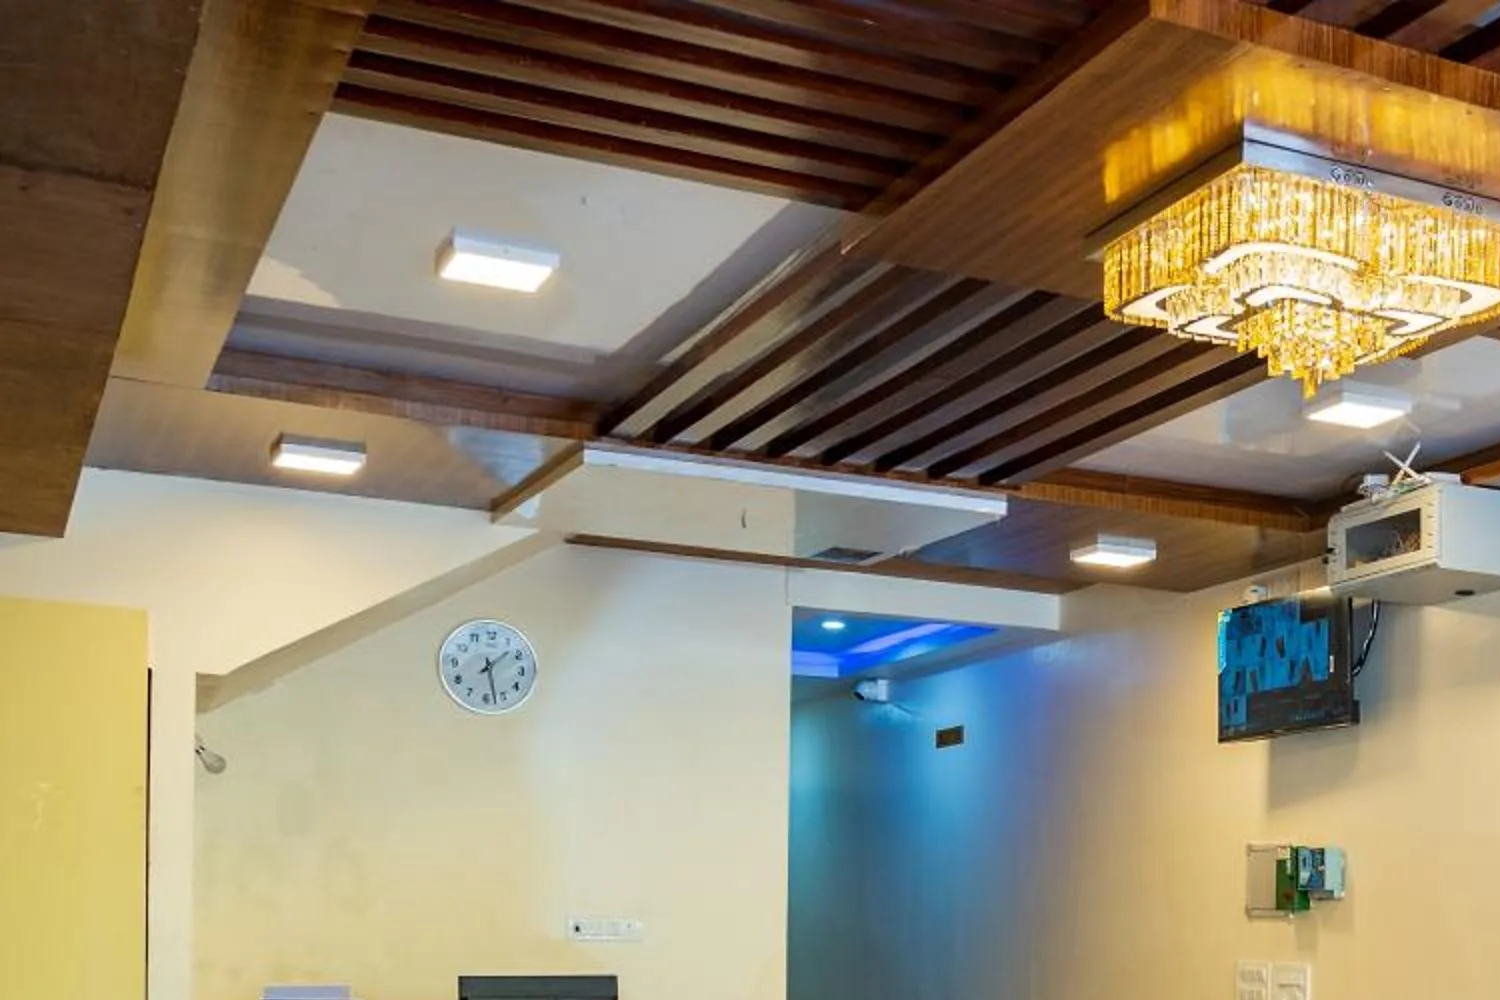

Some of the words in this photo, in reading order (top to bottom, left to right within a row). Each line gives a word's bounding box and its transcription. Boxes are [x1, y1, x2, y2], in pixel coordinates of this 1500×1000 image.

[469, 633, 480, 643] 11
[515, 650, 523, 660] 2
[450, 657, 459, 668] 9
[517, 665, 525, 677] 3
[454, 673, 462, 685] 8
[512, 681, 519, 691] 4
[466, 687, 473, 697] 7
[499, 691, 507, 701] 5
[482, 692, 490, 704] 6
